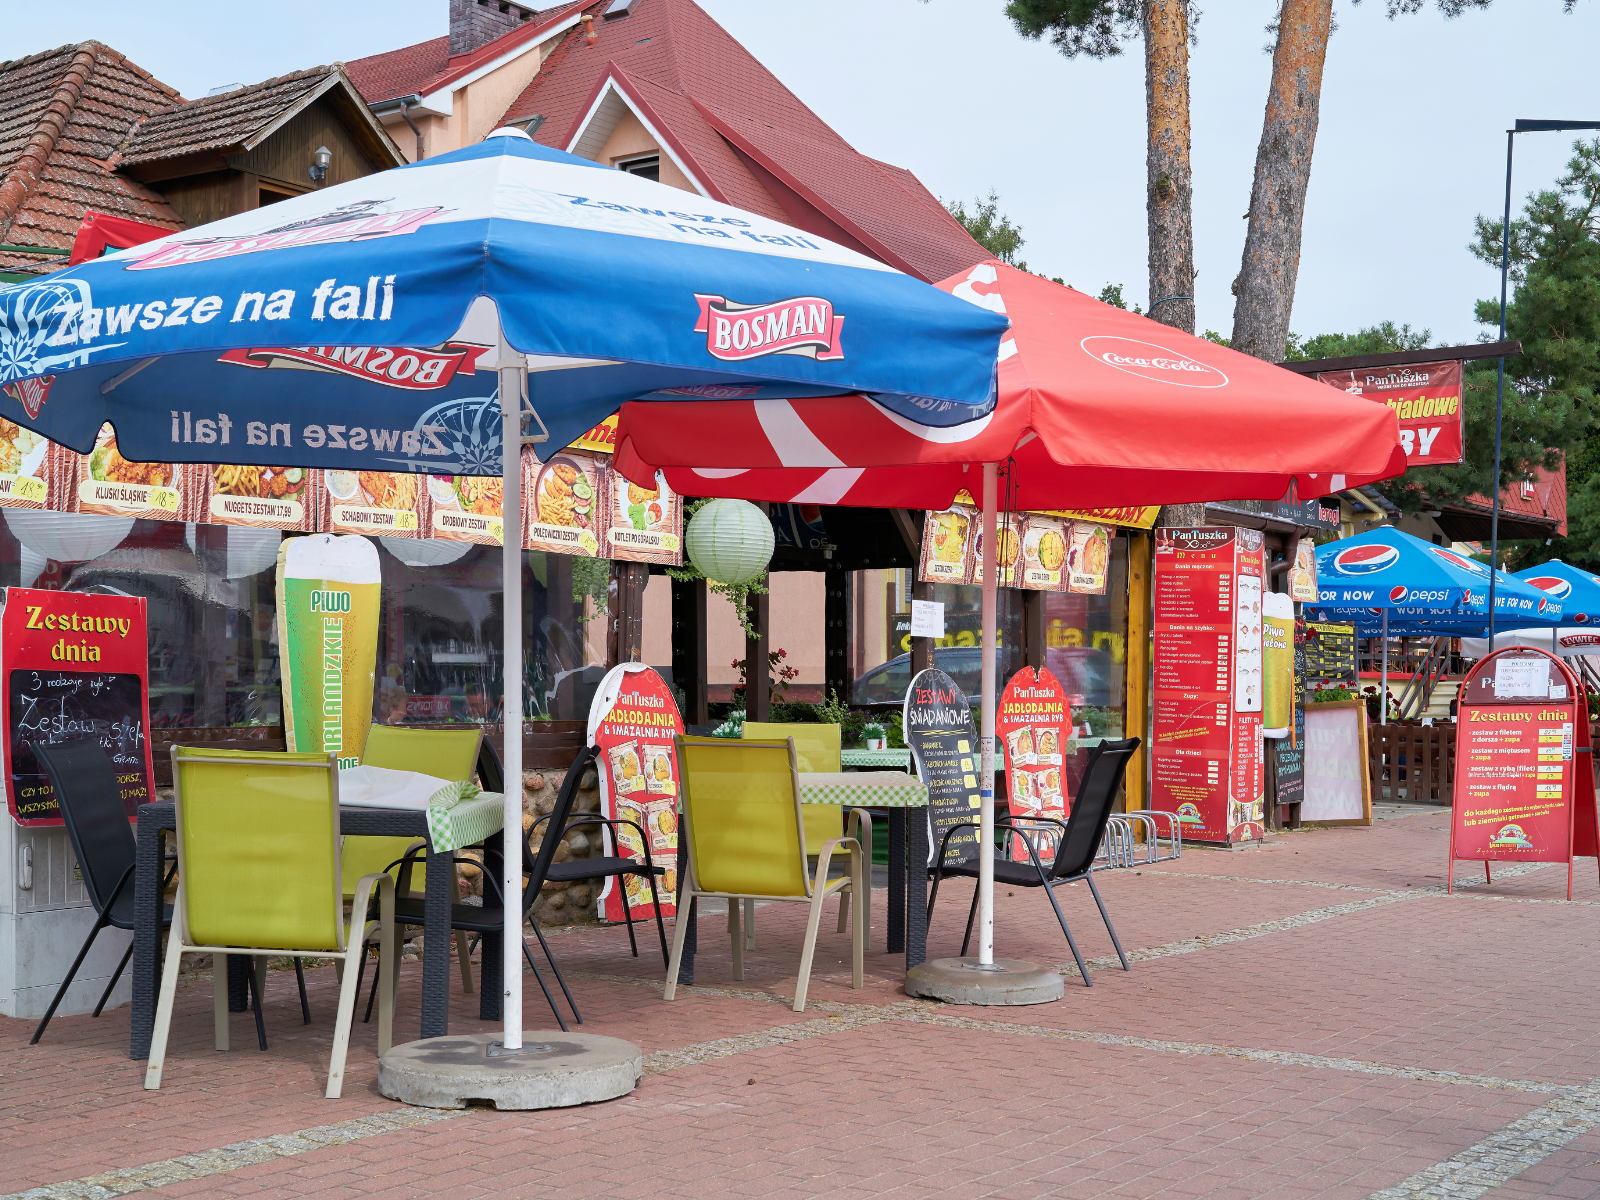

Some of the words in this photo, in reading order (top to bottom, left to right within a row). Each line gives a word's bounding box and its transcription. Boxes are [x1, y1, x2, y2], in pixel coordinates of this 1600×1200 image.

[557, 192, 751, 228] Zawsze
[160, 213, 411, 265] BOSMAN
[670, 223, 733, 240] na
[739, 228, 822, 251] fali
[51, 296, 222, 347] Zawsze
[230, 288, 297, 323] na
[311, 275, 397, 321] fali
[714, 303, 828, 351] BOSMAN
[1102, 352, 1210, 373] Coca-Cola
[1366, 371, 1429, 386] PanTuszka
[1379, 395, 1459, 420] biadowe
[1400, 426, 1441, 457] BY
[96, 486, 119, 500] KLUSKI
[120, 484, 147, 505] ŚLĄSKIE
[224, 500, 251, 515] NUGGETS
[252, 502, 276, 517] ZESTAW
[1318, 503, 1340, 526] ierogi
[341, 510, 372, 524] SCHABOWY
[372, 512, 393, 525] ZESTAW
[1172, 529, 1228, 541] PanTuszka
[1343, 590, 1374, 601] NOW
[1409, 589, 1449, 603] pepsi
[1495, 596, 1505, 607] IVE
[1507, 597, 1519, 608] FOR
[1519, 599, 1534, 610] NOW
[1545, 602, 1563, 615] pepsi
[25, 605, 131, 639] Zestawy
[1262, 623, 1285, 637] Piwo
[1263, 638, 1287, 650] ielone
[1563, 634, 1599, 646] ŻYWIEC
[51, 638, 101, 662] dnia
[30, 671, 42, 691] 3
[47, 672, 82, 695] rodzaje
[323, 617, 343, 752] IRLANDZKIE
[614, 689, 664, 708] PanTuszka
[1013, 686, 1055, 699] PanTuszka
[18, 694, 95, 733] Zestaw
[1003, 702, 1064, 715] JADŁODAJNIA
[1469, 710, 1533, 723] Zestawy
[1537, 709, 1568, 721] dnia
[1003, 715, 1009, 724] &
[1010, 711, 1050, 723] SMAŻALNIA
[1051, 714, 1064, 723] RYB
[604, 724, 610, 735] &
[612, 722, 659, 739] SMAŻALNIA
[1498, 747, 1531, 755] miętusem
[1464, 809, 1474, 817] do
[1475, 808, 1502, 816] każdego
[1464, 819, 1477, 827] lub
[1477, 814, 1508, 825] ziemniaki
[1508, 813, 1532, 821] gotowane
